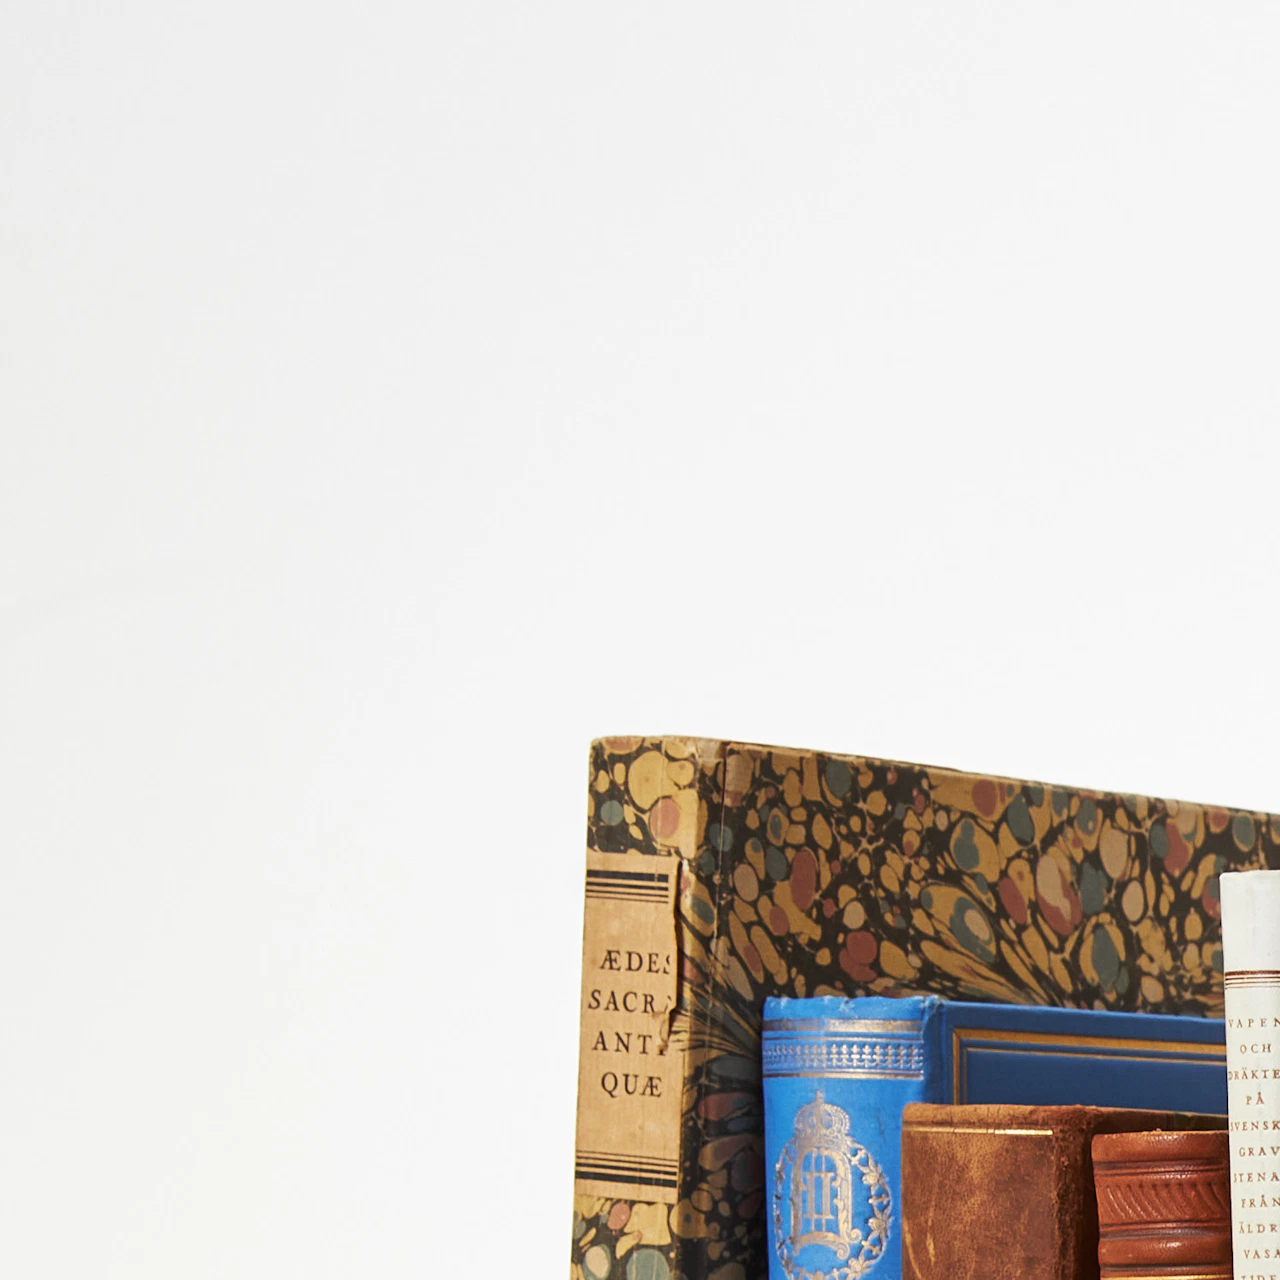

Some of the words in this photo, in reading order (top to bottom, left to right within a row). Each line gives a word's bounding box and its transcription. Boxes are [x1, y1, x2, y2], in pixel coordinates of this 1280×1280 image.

[588, 989, 672, 1014] SACR
[1240, 1044, 1272, 1054] OCH
[601, 1071, 662, 1098] QUÆ
[1246, 1091, 1264, 1105] PÅ
[1239, 1146, 1280, 1157] GRAV
